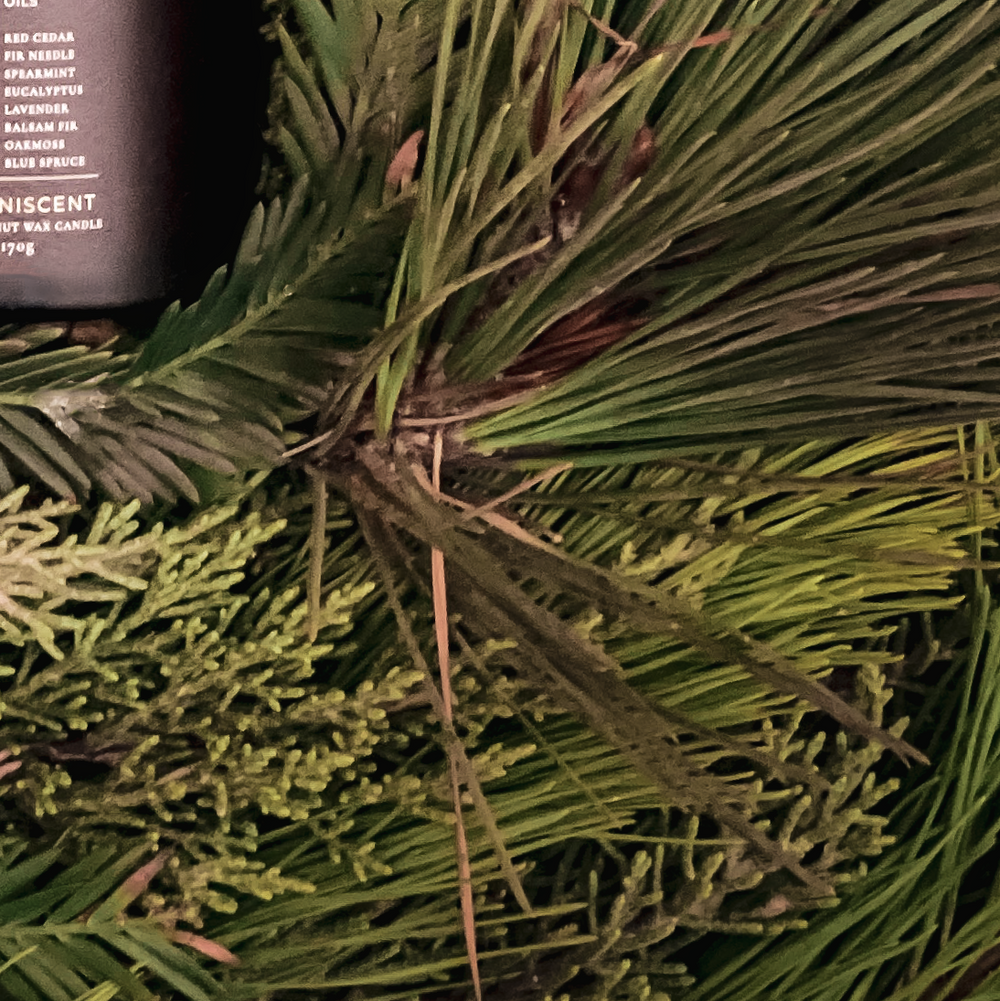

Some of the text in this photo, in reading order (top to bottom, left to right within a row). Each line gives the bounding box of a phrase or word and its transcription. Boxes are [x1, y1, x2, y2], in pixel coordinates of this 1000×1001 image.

[5, 32, 74, 43] RED CEDAR
[4, 49, 74, 61] FIR NEEDLE
[4, 67, 76, 79] SPEARMINT
[5, 85, 83, 97] EUCALYPTUS
[5, 103, 69, 115] LAVENDER
[5, 121, 78, 133] BALSAM FIR
[4, 139, 65, 151] OAKMOSS
[5, 156, 85, 168] BLUE SPRUCE
[24, 220, 51, 232] WAX
[55, 218, 103, 231] CANDLE
[1, 242, 34, 256] 170g
